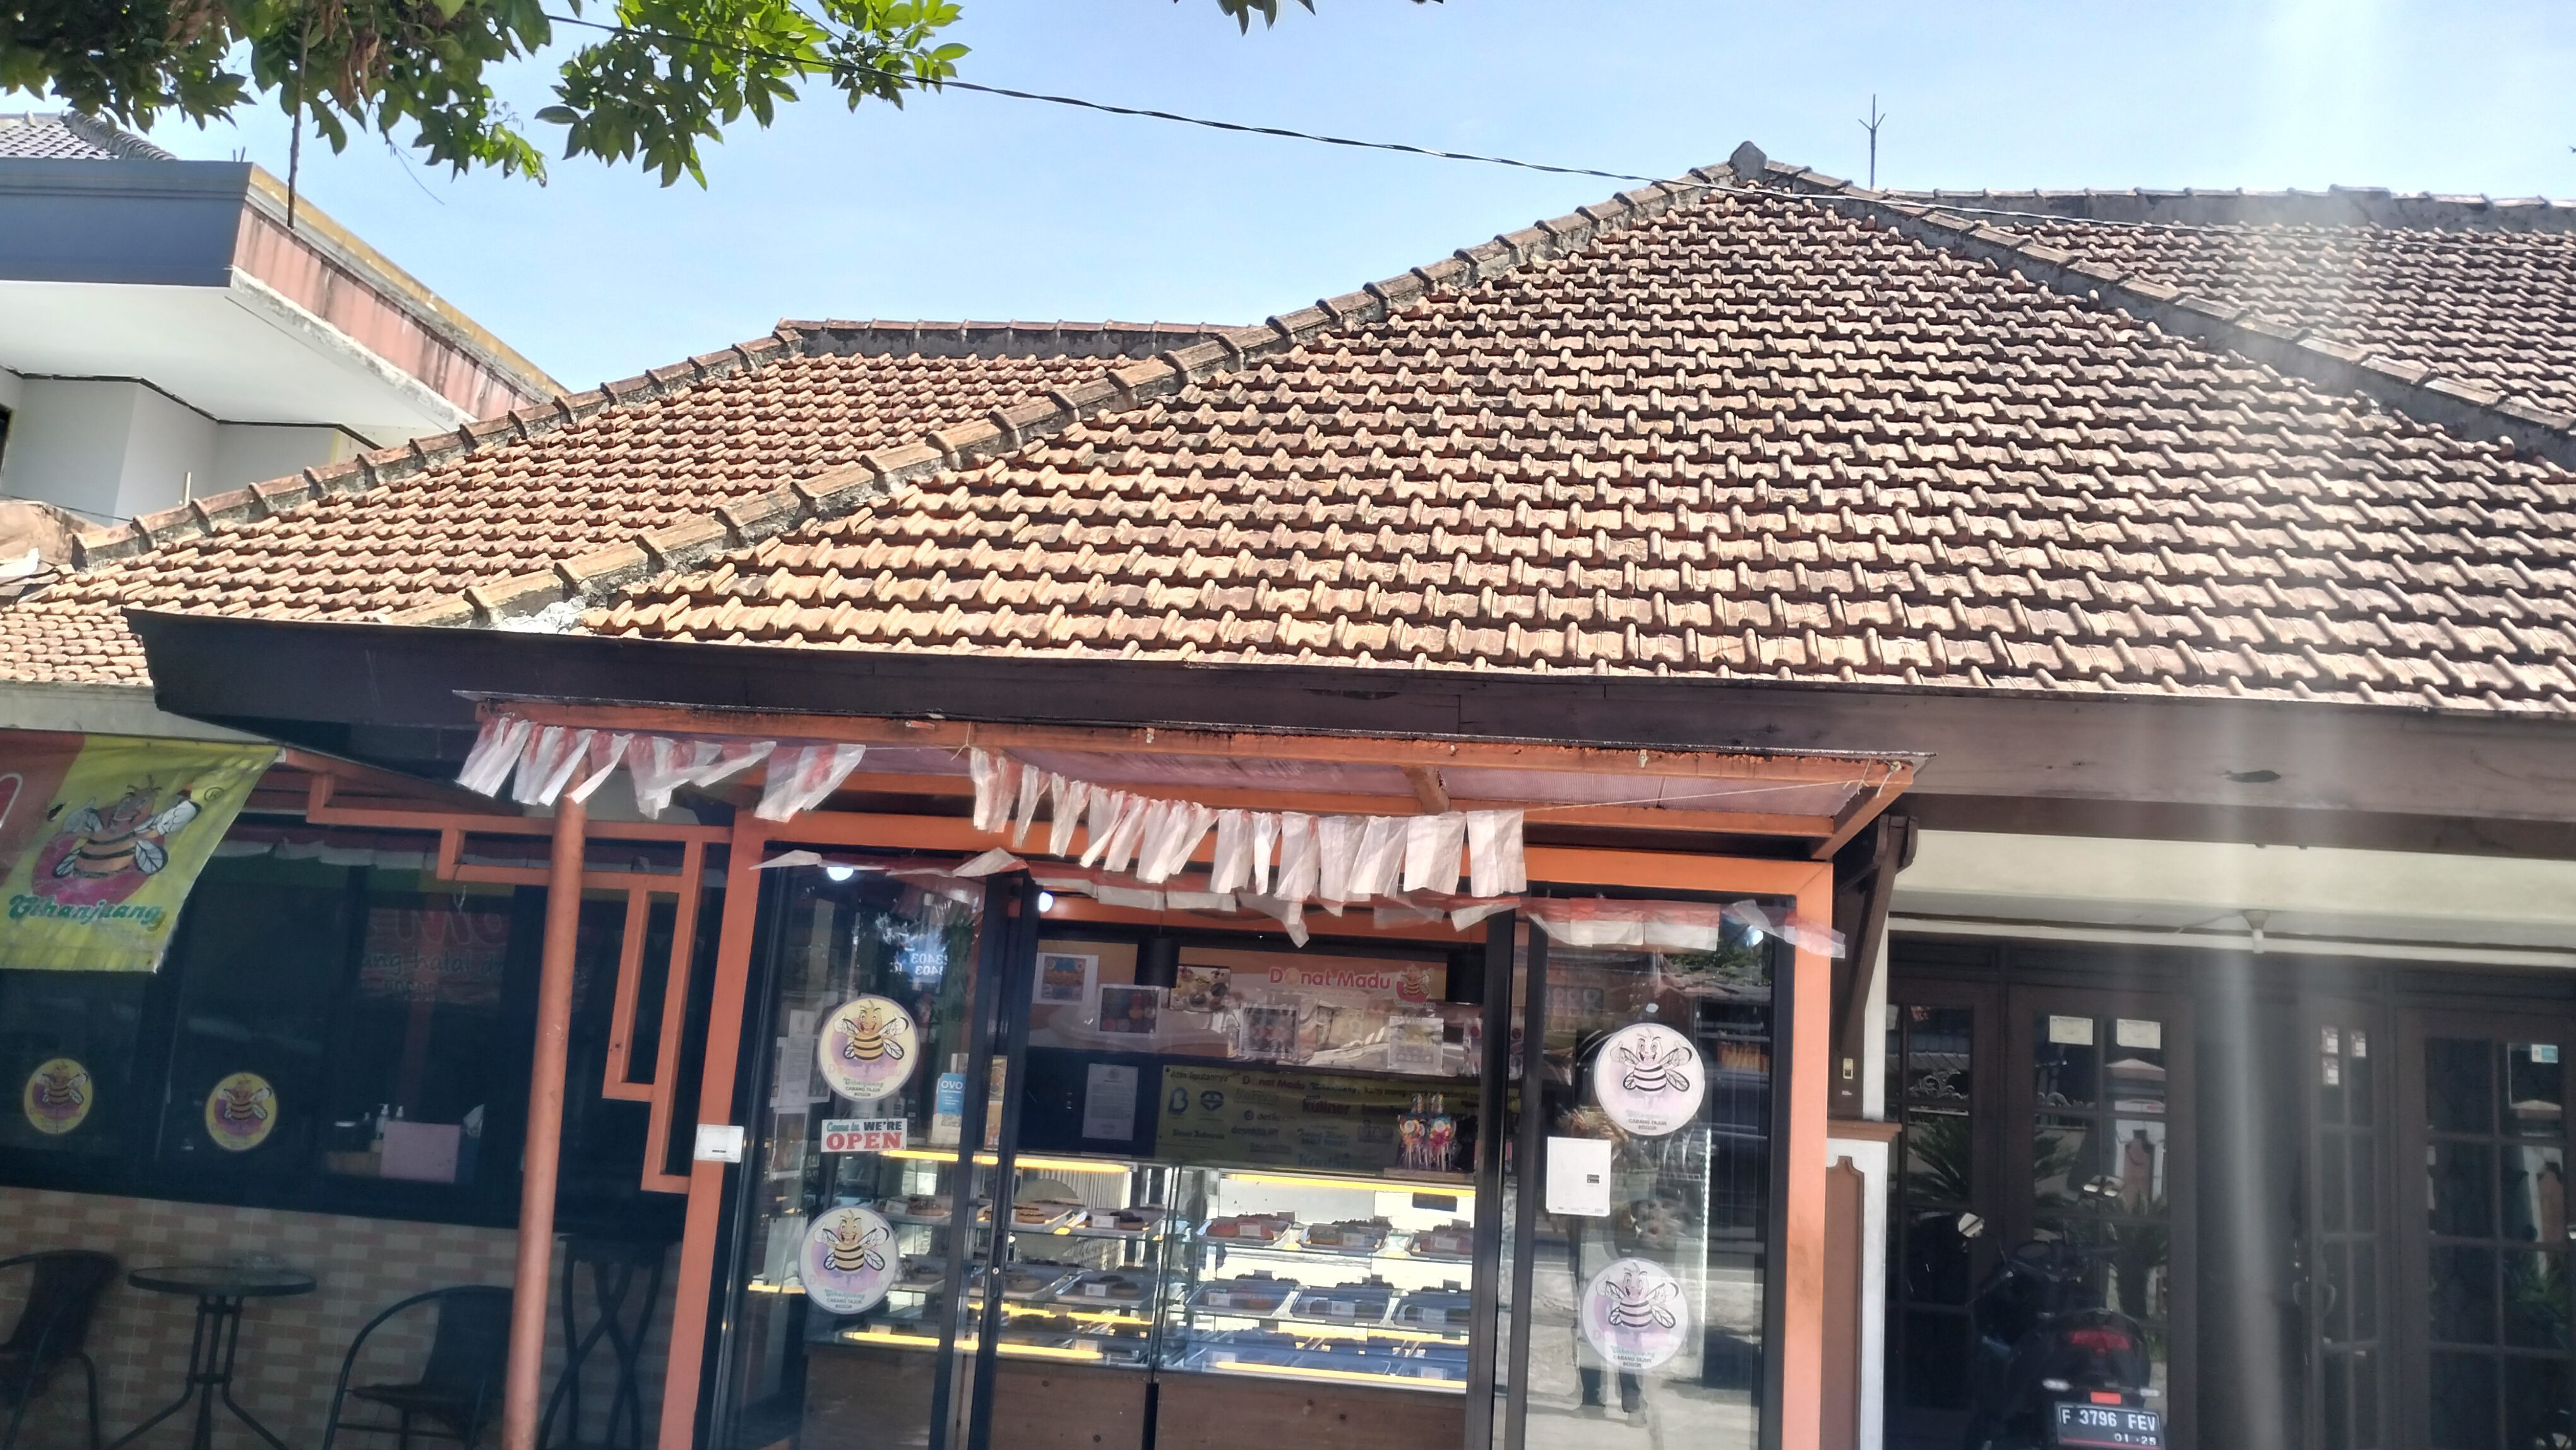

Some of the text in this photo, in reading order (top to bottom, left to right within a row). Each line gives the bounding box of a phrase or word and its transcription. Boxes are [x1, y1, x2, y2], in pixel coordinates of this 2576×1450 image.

[1337, 971, 1392, 990] Madu
[941, 1080, 963, 1089] OVO
[826, 1122, 849, 1132] Come
[864, 1121, 902, 1131] WE'RE
[826, 1132, 902, 1150] OPEN
[2061, 1409, 2156, 1432] F 3796 FEV
